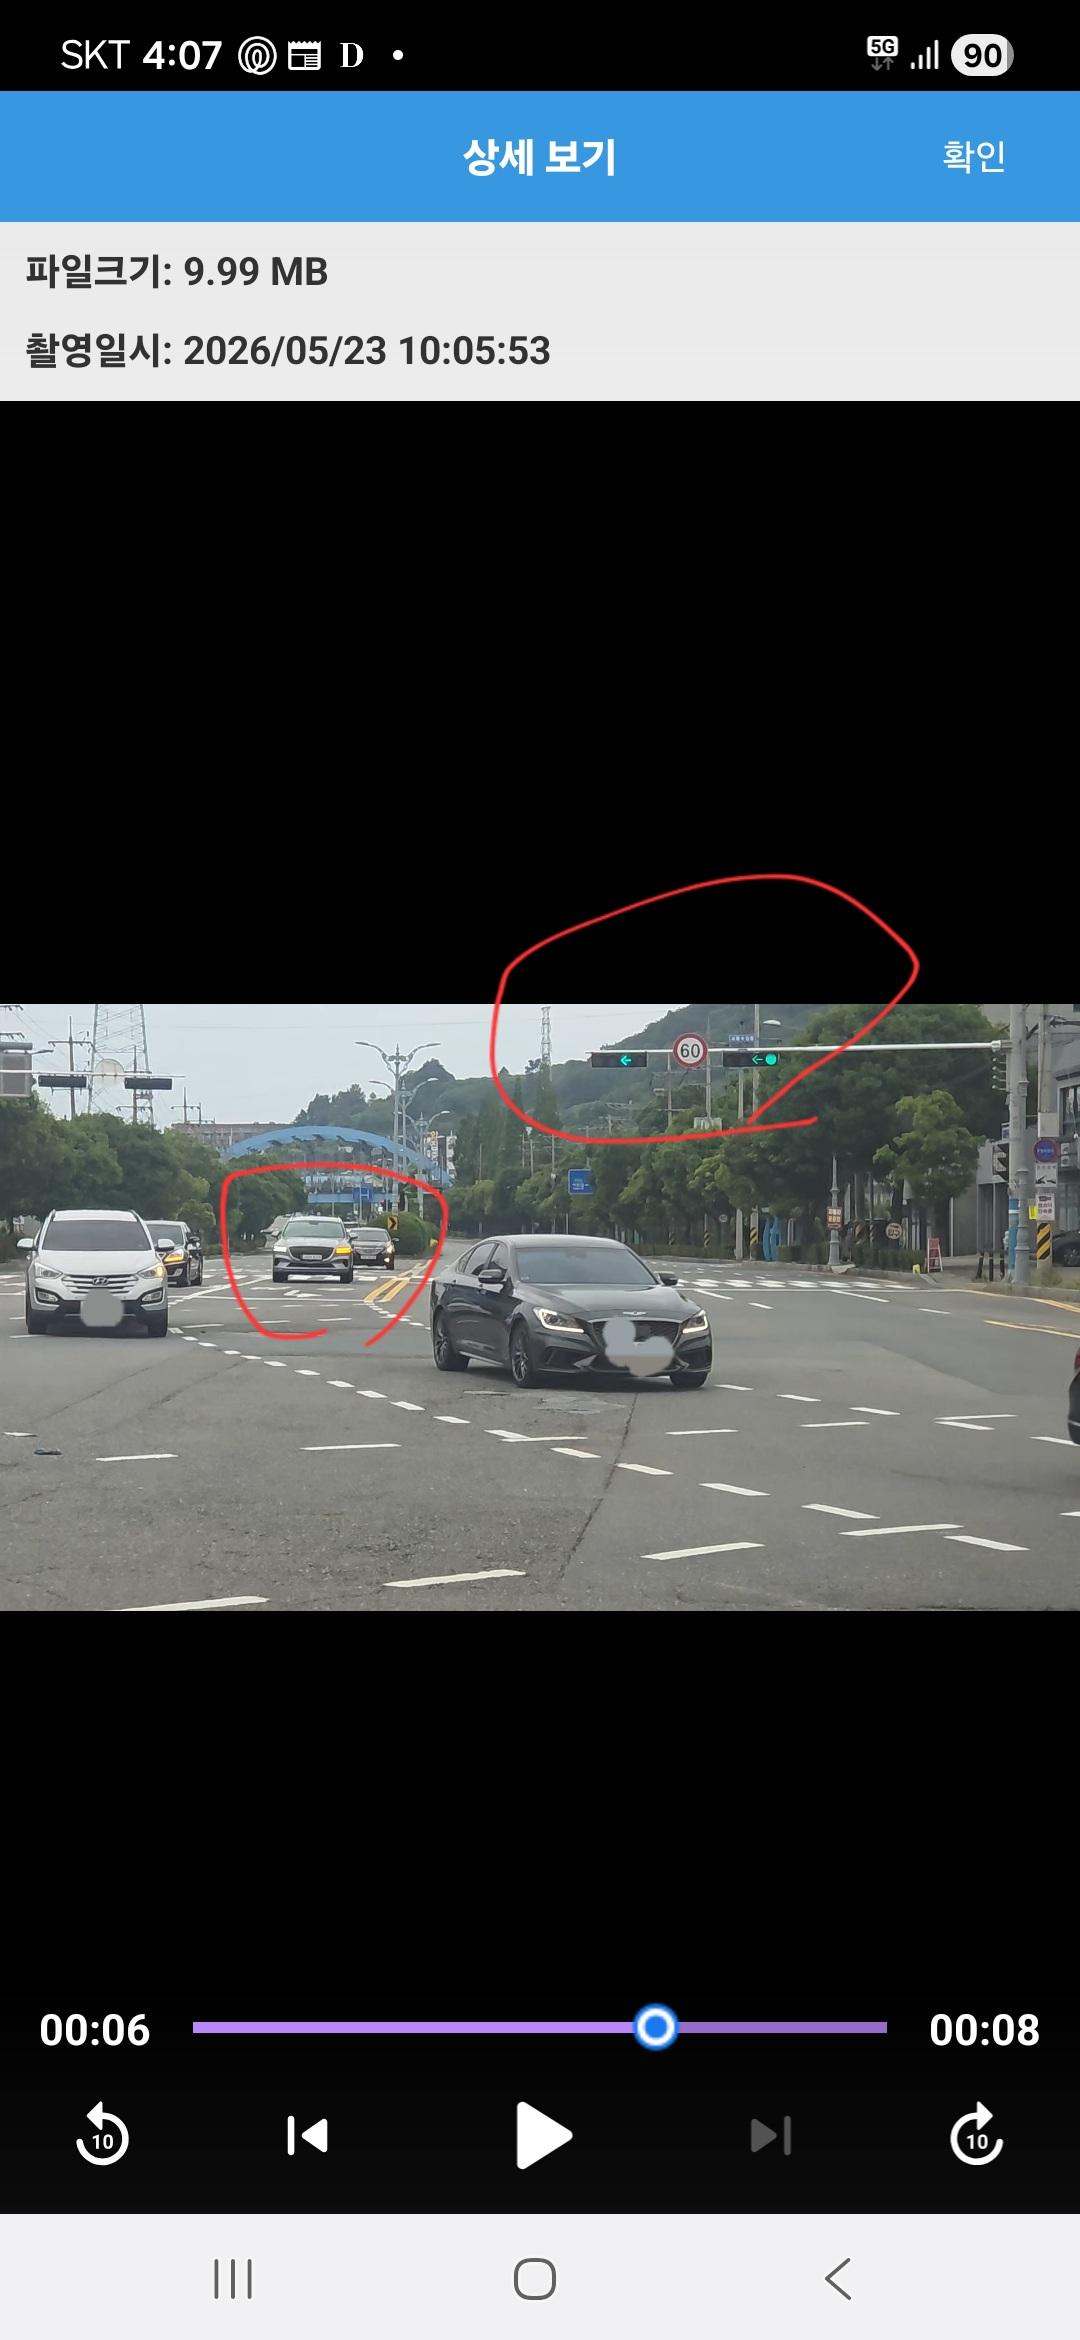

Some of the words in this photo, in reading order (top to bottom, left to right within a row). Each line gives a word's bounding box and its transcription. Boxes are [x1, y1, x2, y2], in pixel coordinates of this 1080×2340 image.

[61, 39, 130, 69] SKT
[143, 40, 222, 70] 4:07
[340, 43, 363, 67] D
[871, 39, 894, 54] 5G
[964, 43, 1002, 68] 90
[464, 139, 533, 176] 상세
[546, 139, 614, 176] 보기
[944, 141, 1004, 174] 확인
[27, 254, 171, 289] 파일크기:
[185, 257, 258, 285] 9.99
[272, 257, 327, 285] MB
[26, 333, 171, 368] 촬영일시:
[184, 336, 386, 367] 2026/05/23
[400, 336, 550, 365] 10:05:53
[680, 1043, 701, 1058] 60
[41, 2014, 150, 2046] 00:06
[931, 2014, 1039, 2046] 00:08
[92, 2133, 113, 2149] 10
[967, 2133, 988, 2149] 10
